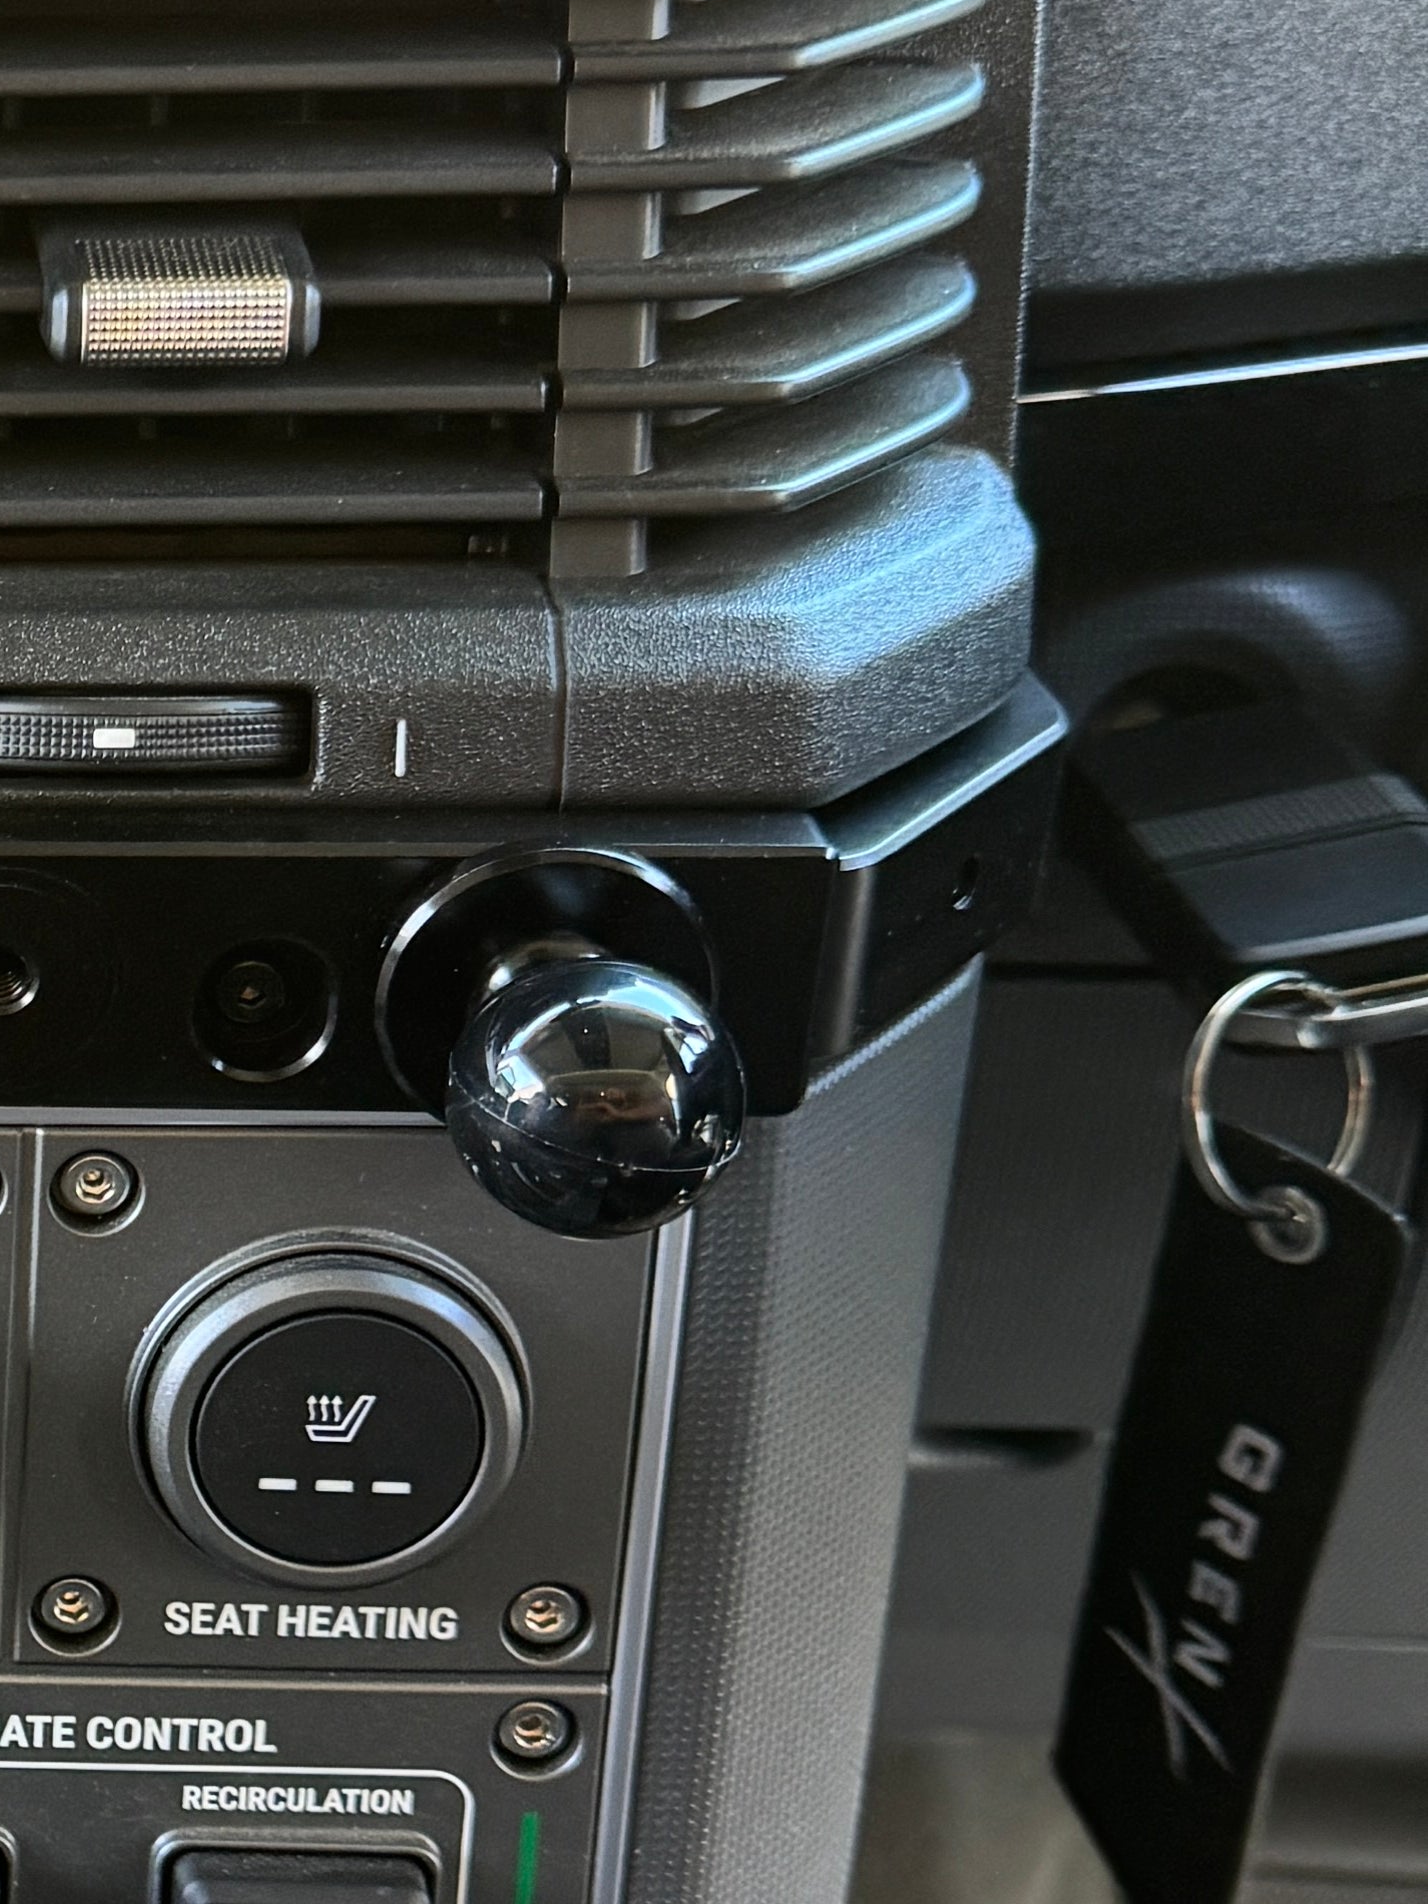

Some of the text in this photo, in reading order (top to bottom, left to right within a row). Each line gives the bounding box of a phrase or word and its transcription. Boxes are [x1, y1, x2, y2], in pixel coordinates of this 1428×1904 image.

[1169, 1423, 1284, 1690] GREN
[165, 1602, 457, 1639] SEAT HEATING
[87, 1716, 277, 1752] CONTROL
[182, 1786, 414, 1814] RECIRCULATION
